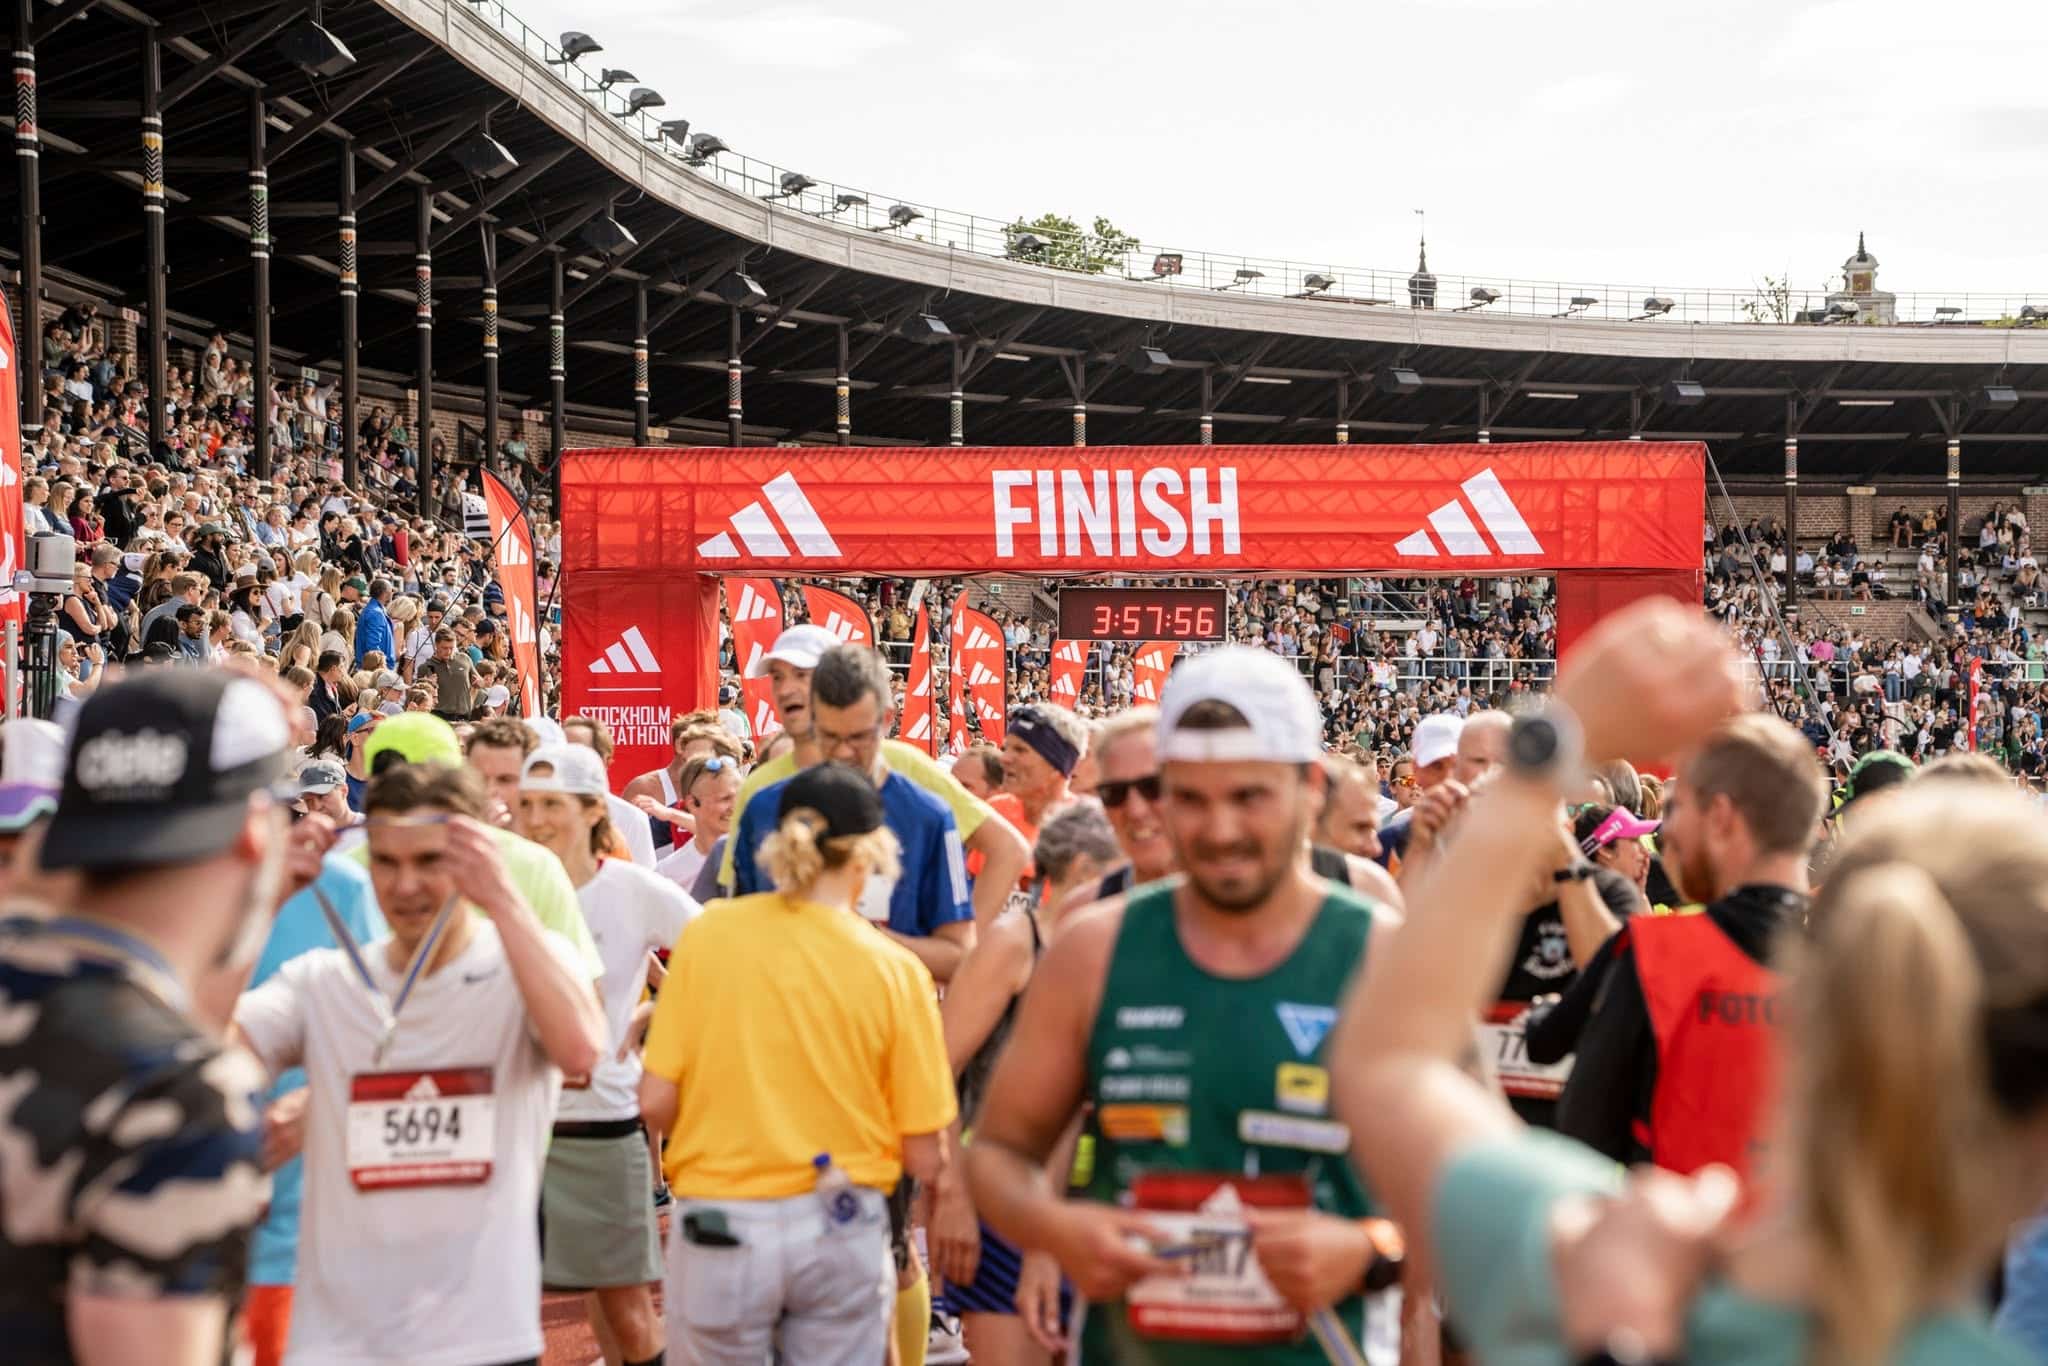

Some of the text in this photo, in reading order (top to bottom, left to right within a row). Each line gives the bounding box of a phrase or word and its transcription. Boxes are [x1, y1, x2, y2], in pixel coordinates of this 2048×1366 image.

[992, 467, 1241, 558] FINISH
[1092, 606, 1216, 636] 3:57:56
[579, 706, 671, 726] STOCKHOLM
[606, 726, 671, 745] RATHON
[384, 1106, 461, 1146] 5694
